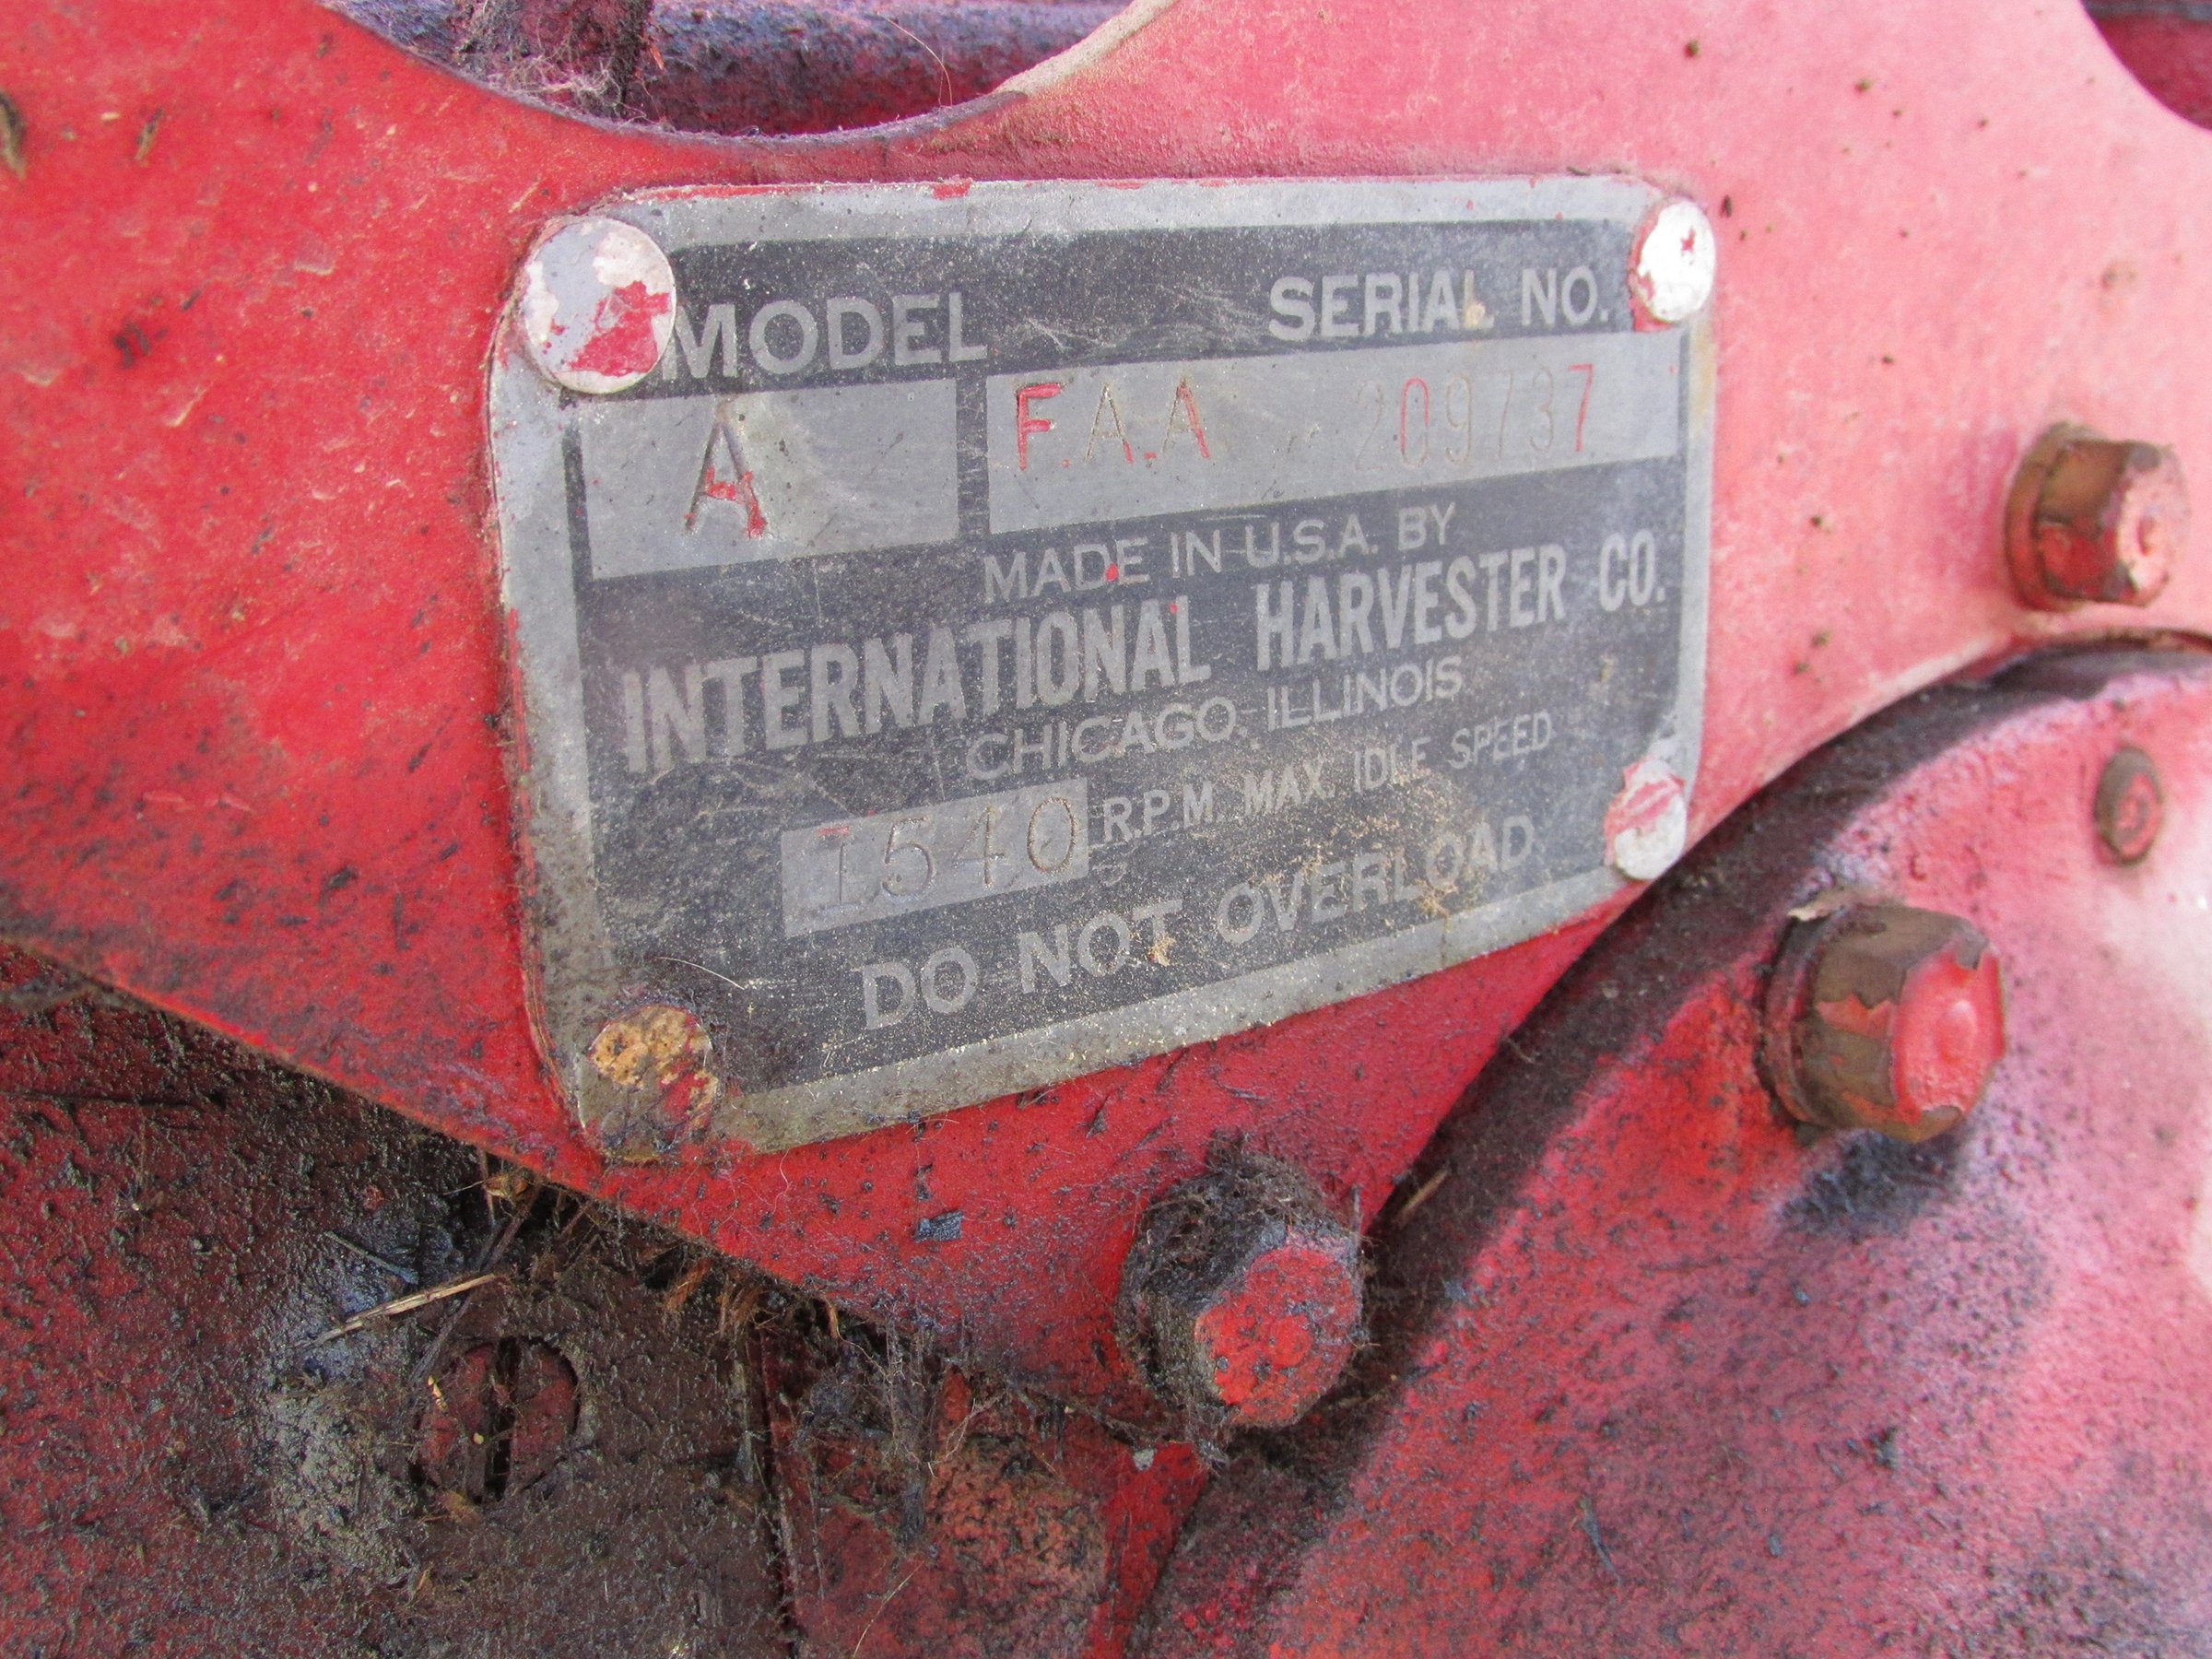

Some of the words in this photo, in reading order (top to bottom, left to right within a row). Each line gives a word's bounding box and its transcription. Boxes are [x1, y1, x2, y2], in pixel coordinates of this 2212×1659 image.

[662, 290, 988, 381] MODEL
[1268, 268, 1495, 343] SERIAL
[1521, 265, 1609, 327] NO.
[1355, 362, 1594, 473] 209737
[685, 401, 767, 539] A
[982, 536, 1152, 606] MADE
[1170, 528, 1222, 578] IN
[1244, 513, 1379, 571] U.S.A.
[1397, 502, 1456, 552] BY
[619, 594, 1213, 781] INTERNATIONAL
[1253, 544, 1569, 671] HARVESTER
[1598, 528, 1666, 612] CO.
[1266, 654, 1465, 732] ILLINOIS
[1448, 711, 1554, 771] SPEED
[860, 945, 981, 1030] DO
[1018, 899, 1183, 994] NOT
[1217, 815, 1535, 947] OVERLOAD
